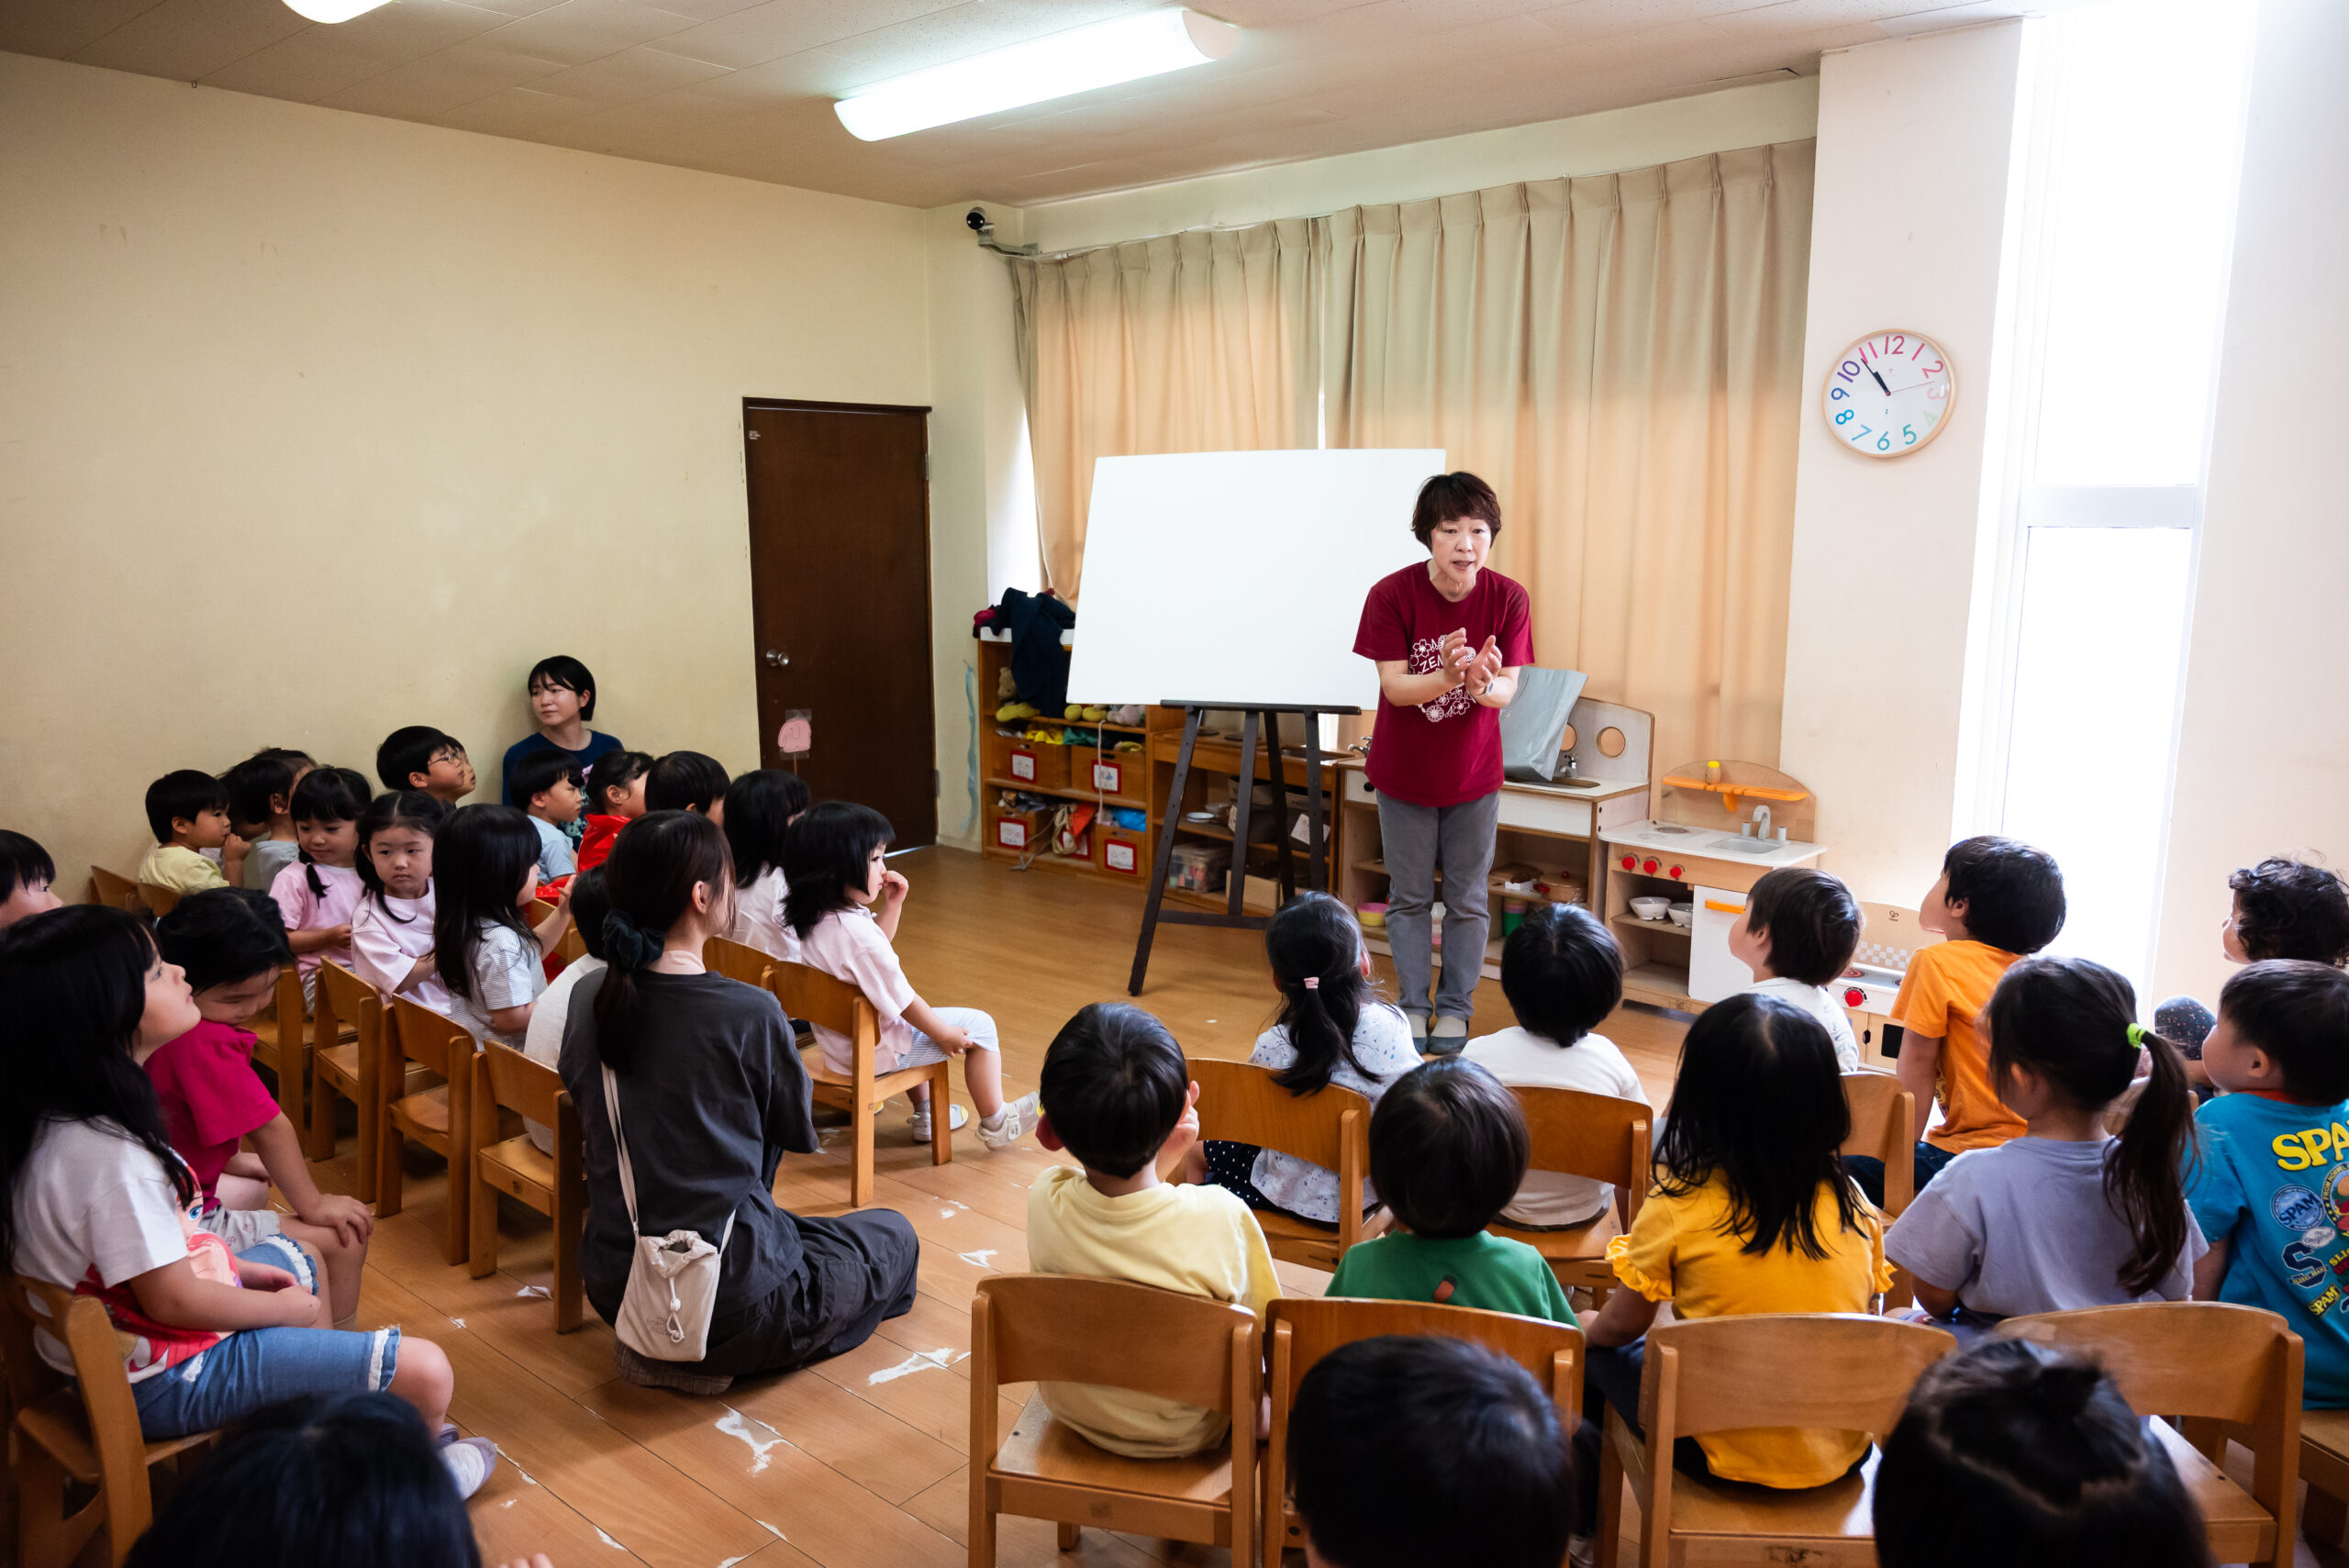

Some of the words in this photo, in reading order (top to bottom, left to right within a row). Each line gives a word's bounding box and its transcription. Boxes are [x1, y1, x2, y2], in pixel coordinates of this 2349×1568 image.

[1858, 341, 1878, 364] 11
[1884, 335, 1905, 355] 12
[1911, 342, 1925, 361] 1
[1836, 360, 1861, 384] 10
[1921, 360, 1944, 379] 2
[1831, 387, 1851, 401] 9
[1927, 386, 1948, 400] 3
[1835, 409, 1854, 425] 8
[1922, 409, 1939, 428] 4
[1851, 424, 1873, 441] 7
[1876, 431, 1890, 450] 6
[1902, 424, 1917, 445] 5
[2272, 1120, 2349, 1171] SPA
[2279, 1193, 2321, 1226] SPAM
[2309, 1285, 2340, 1316] SPAM
